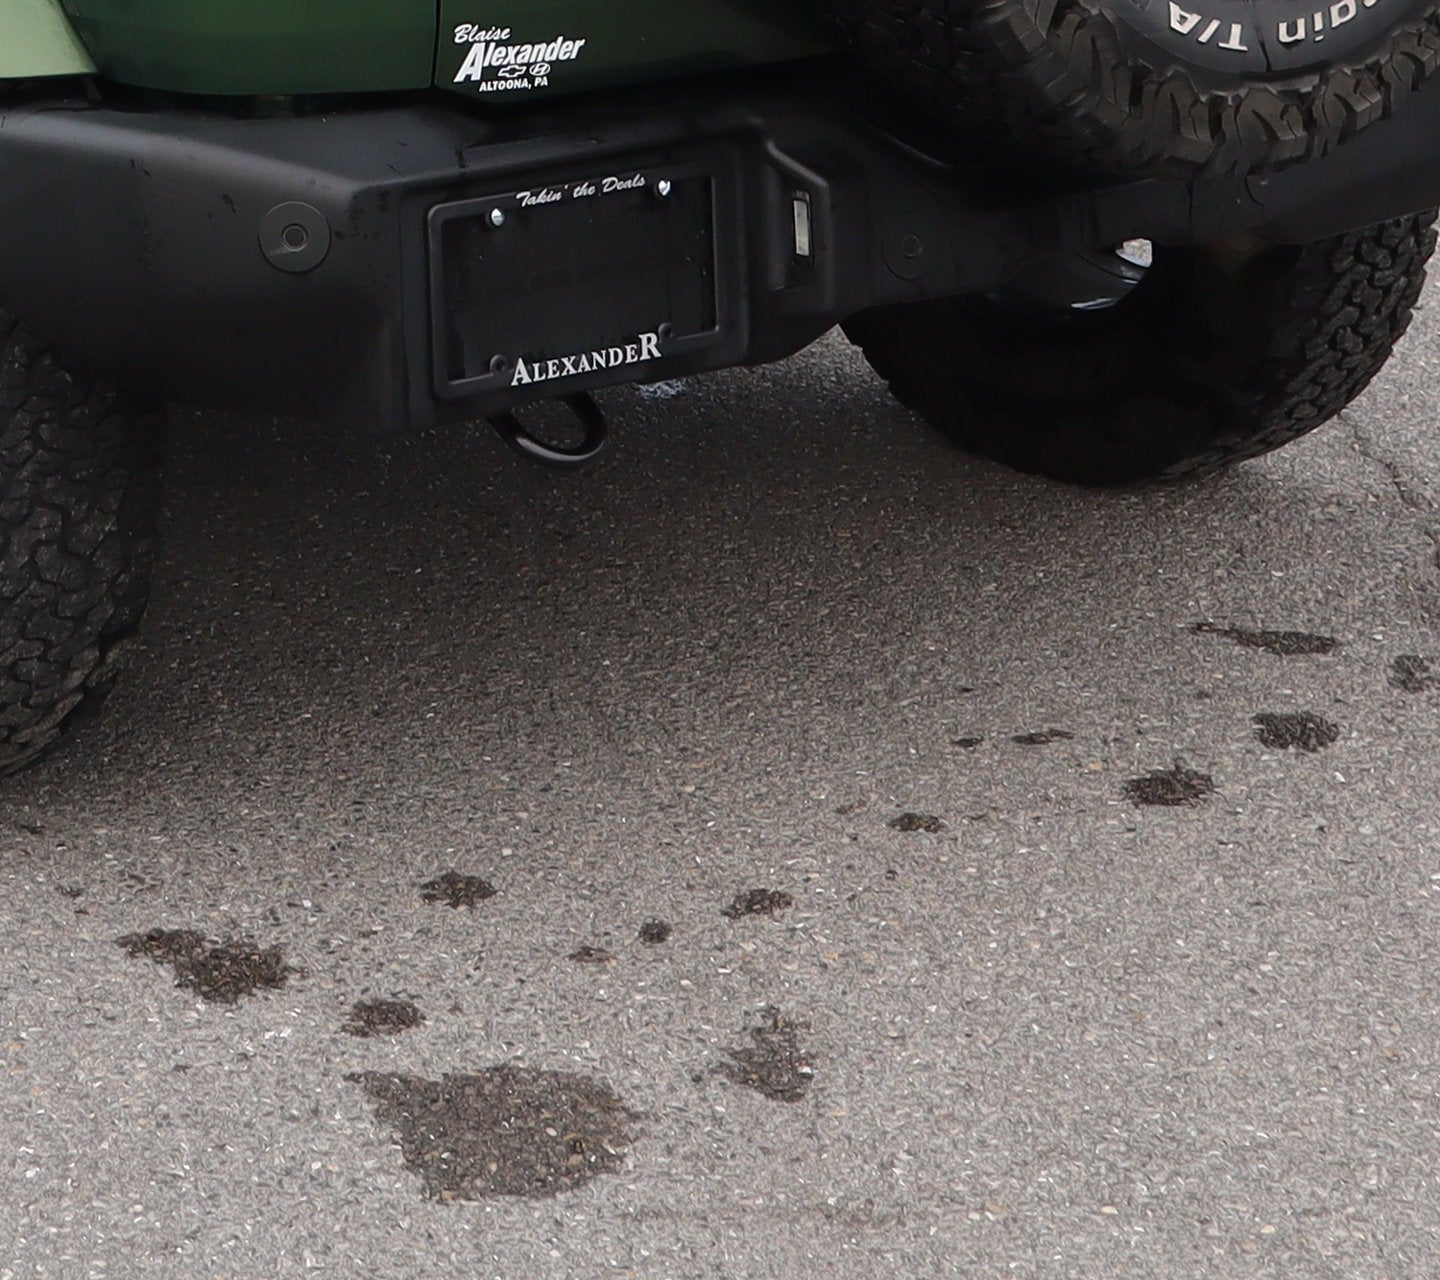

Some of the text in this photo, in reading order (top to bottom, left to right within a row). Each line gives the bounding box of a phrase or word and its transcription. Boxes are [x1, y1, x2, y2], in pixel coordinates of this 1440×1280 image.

[453, 23, 511, 44] Blaise
[1167, 0, 1249, 52] T/A
[453, 36, 586, 82] Alexander
[479, 75, 548, 92] ALTOONA, PA
[515, 173, 647, 208] Takin' the Deals
[510, 331, 663, 387] ALEXANDER
